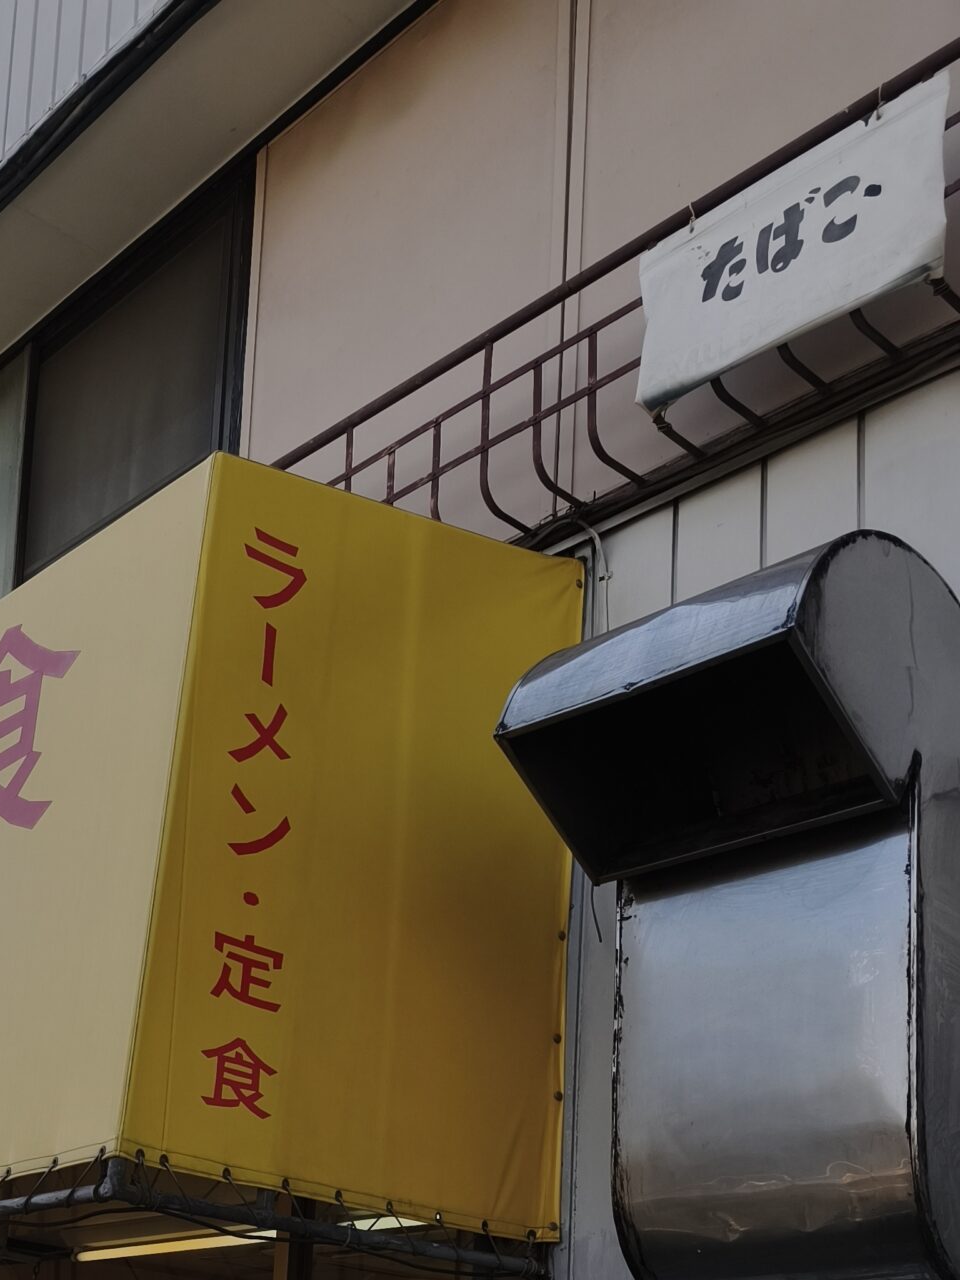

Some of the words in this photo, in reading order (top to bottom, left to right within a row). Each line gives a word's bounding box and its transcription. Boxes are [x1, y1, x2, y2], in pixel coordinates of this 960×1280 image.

[200, 527, 308, 1119] ラーメン・定食
